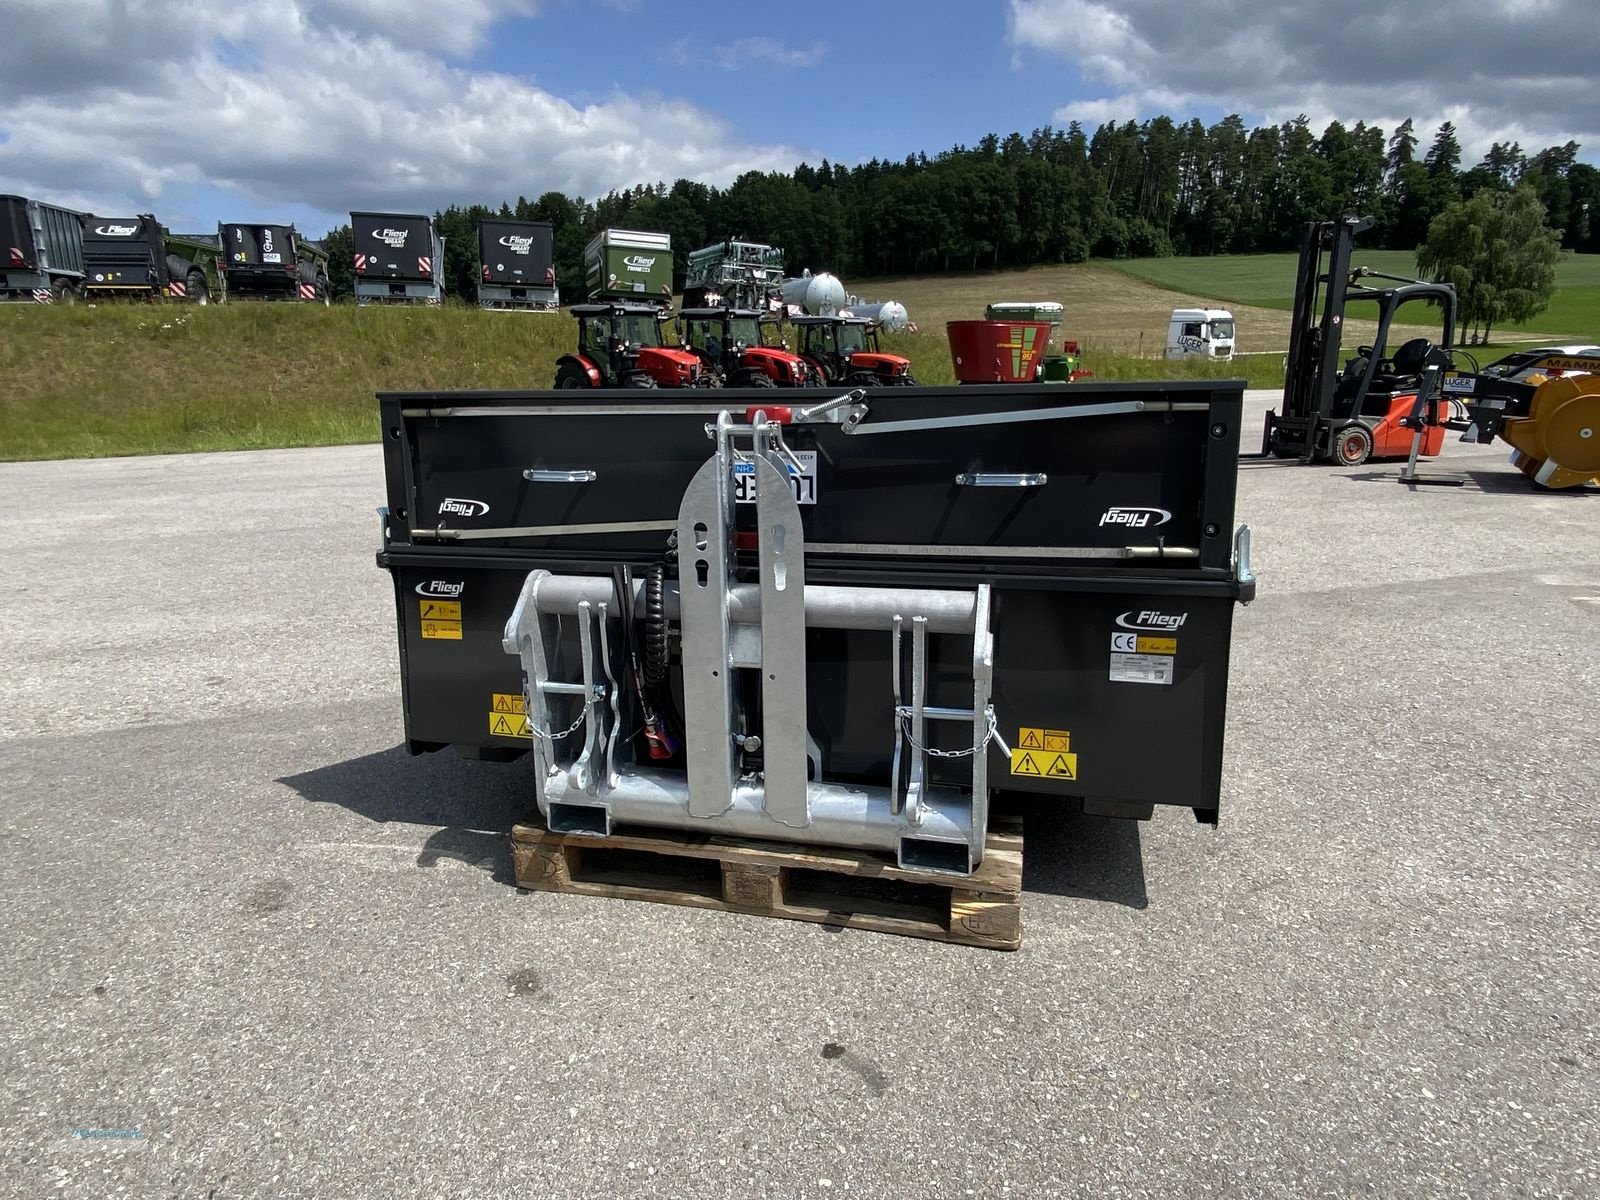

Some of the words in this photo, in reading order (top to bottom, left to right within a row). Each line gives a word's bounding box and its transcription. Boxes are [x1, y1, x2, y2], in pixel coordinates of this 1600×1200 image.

[107, 225, 138, 236] Fliegl
[383, 228, 409, 239] Fliegl
[509, 235, 534, 246] Fliegl
[633, 255, 656, 266] Fliegl
[1176, 335, 1203, 349] LUGER
[1546, 359, 1600, 370] MAMM
[1445, 378, 1471, 386] LUGER
[735, 475, 814, 501] LUER
[438, 498, 475, 517] Fliegl
[1099, 510, 1151, 527] Fliegl
[429, 580, 465, 597] Fliegl
[1136, 610, 1188, 629] Fliegl
